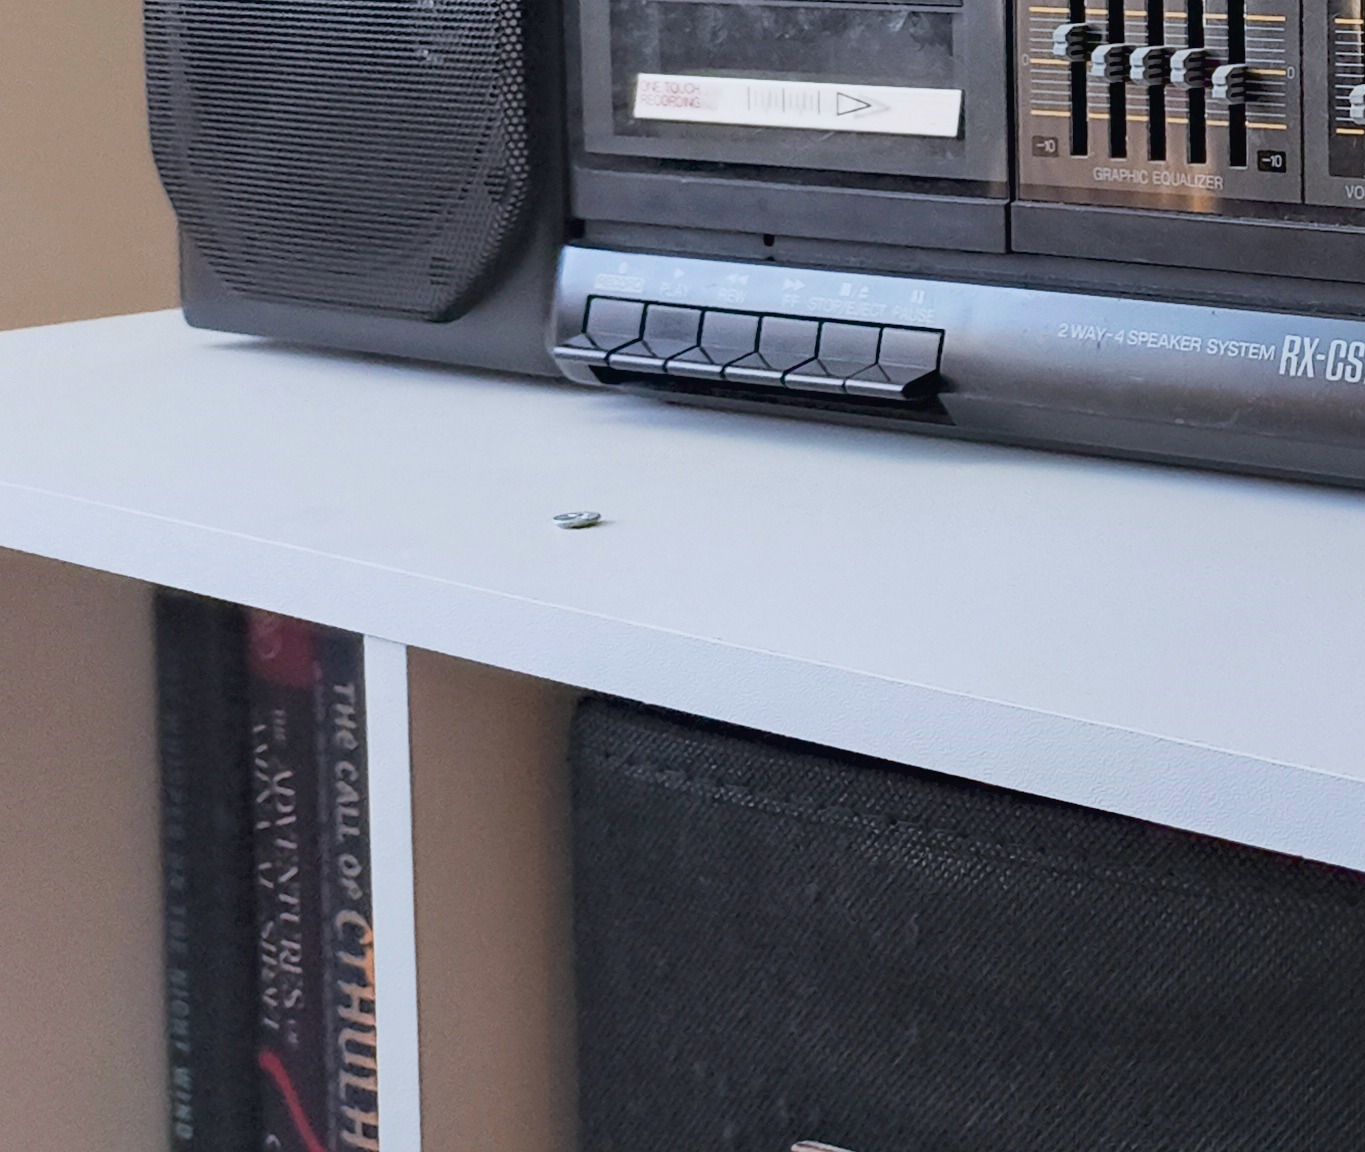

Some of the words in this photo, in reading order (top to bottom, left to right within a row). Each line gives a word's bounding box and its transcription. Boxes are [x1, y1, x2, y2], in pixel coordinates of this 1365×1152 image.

[1092, 166, 1149, 185] GRAPHIC
[1152, 170, 1223, 191] EQUALIZER
[718, 288, 745, 303] REW
[781, 295, 800, 307] FF
[807, 297, 887, 317] STOP/EJECT
[892, 305, 936, 325] PAUSE
[1058, 322, 1069, 338] 2
[1128, 330, 1201, 352] SPEAKER
[1206, 337, 1275, 361] SYSTEM
[332, 683, 358, 751] THE
[335, 761, 360, 841] CALL
[338, 852, 364, 901] OF
[170, 968, 191, 1052] NIGHT
[173, 1067, 194, 1141] WIND
